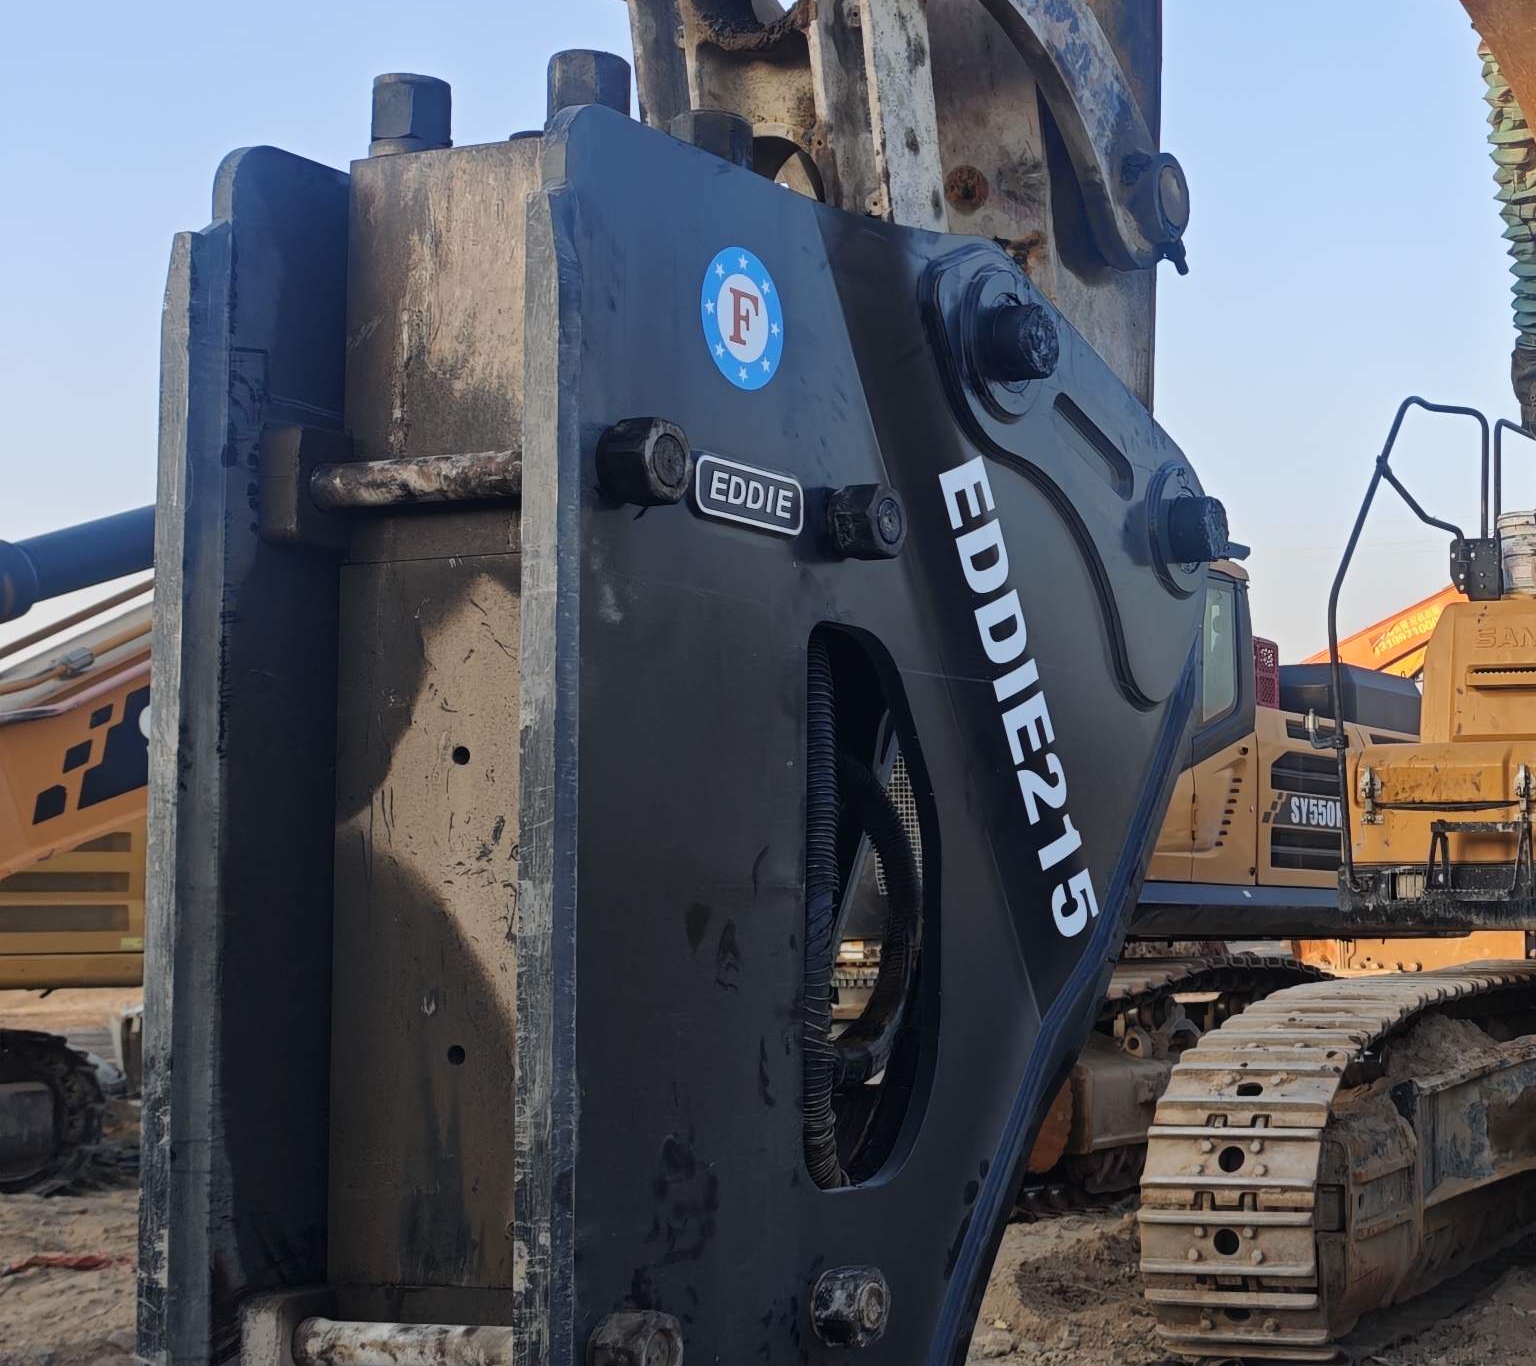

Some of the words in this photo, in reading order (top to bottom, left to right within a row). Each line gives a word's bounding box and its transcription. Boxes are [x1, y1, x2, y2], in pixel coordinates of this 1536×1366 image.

[728, 286, 760, 346] F
[709, 469, 794, 520] EDDIE
[938, 454, 1100, 938] EDDIE215
